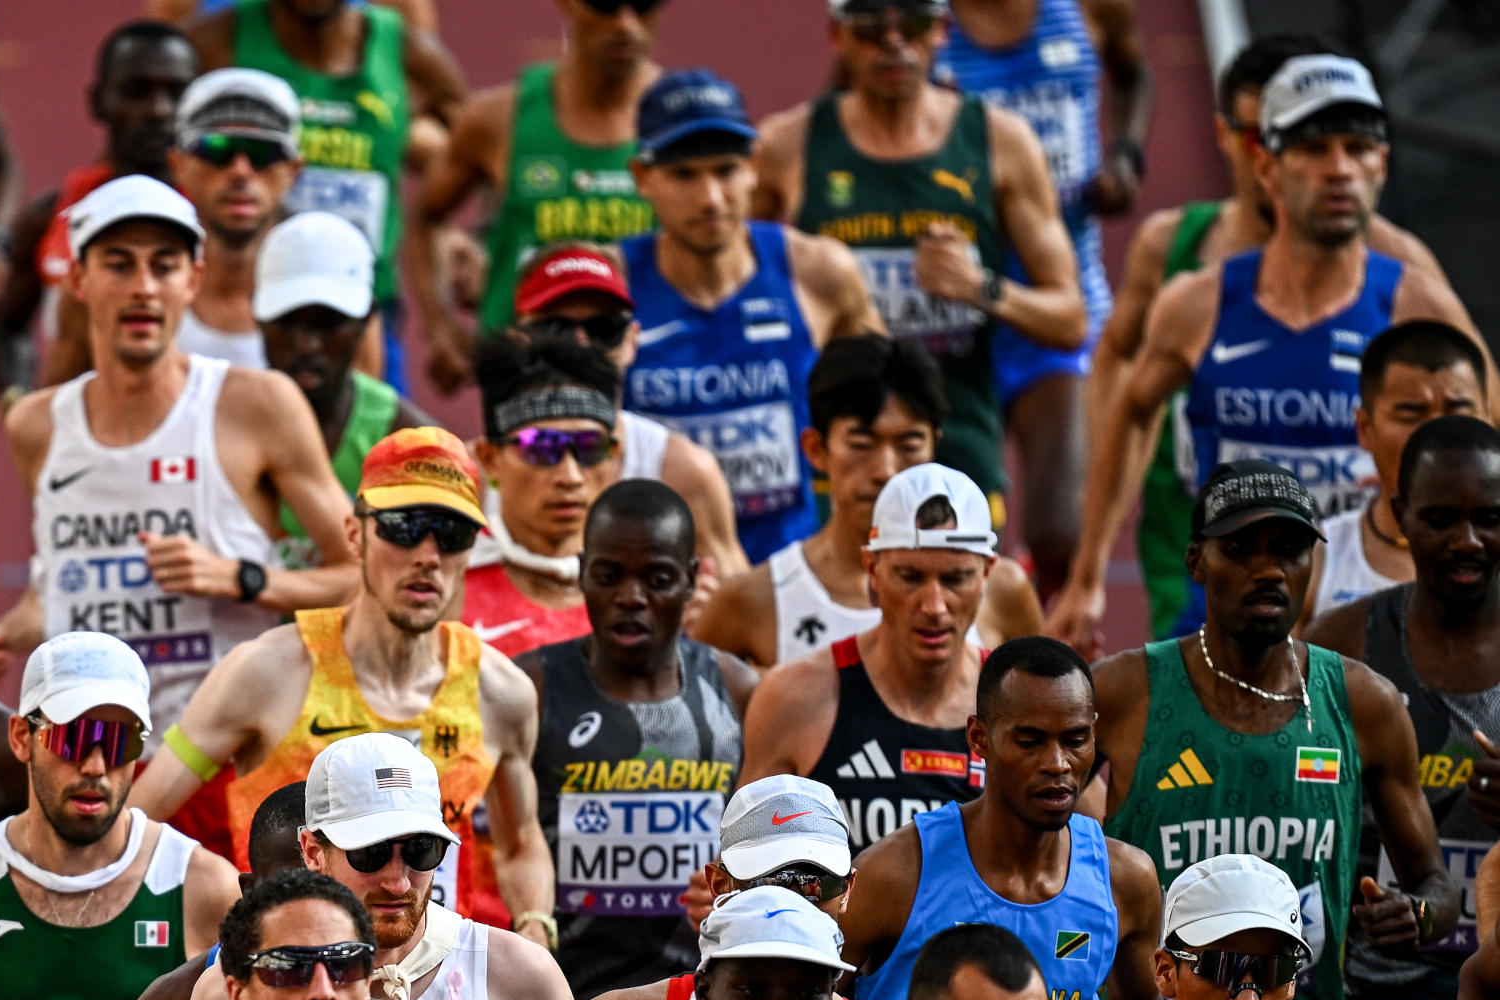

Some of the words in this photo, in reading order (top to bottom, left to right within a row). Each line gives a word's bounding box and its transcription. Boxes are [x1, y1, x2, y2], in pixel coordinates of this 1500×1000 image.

[871, 258, 918, 290] TD
[631, 359, 791, 407] ESTONIA
[404, 460, 468, 483] GERMANY
[1272, 453, 1358, 488] DK
[50, 508, 198, 550] CANADA
[88, 556, 151, 590] TD
[70, 597, 182, 634] KENT
[562, 760, 733, 796] ZIMBABWE
[922, 756, 964, 772] EXTRA
[612, 800, 712, 834] TDK
[842, 797, 942, 847] NOR
[1160, 817, 1335, 870] ETHIOPIA
[570, 844, 716, 880] MPOFU
